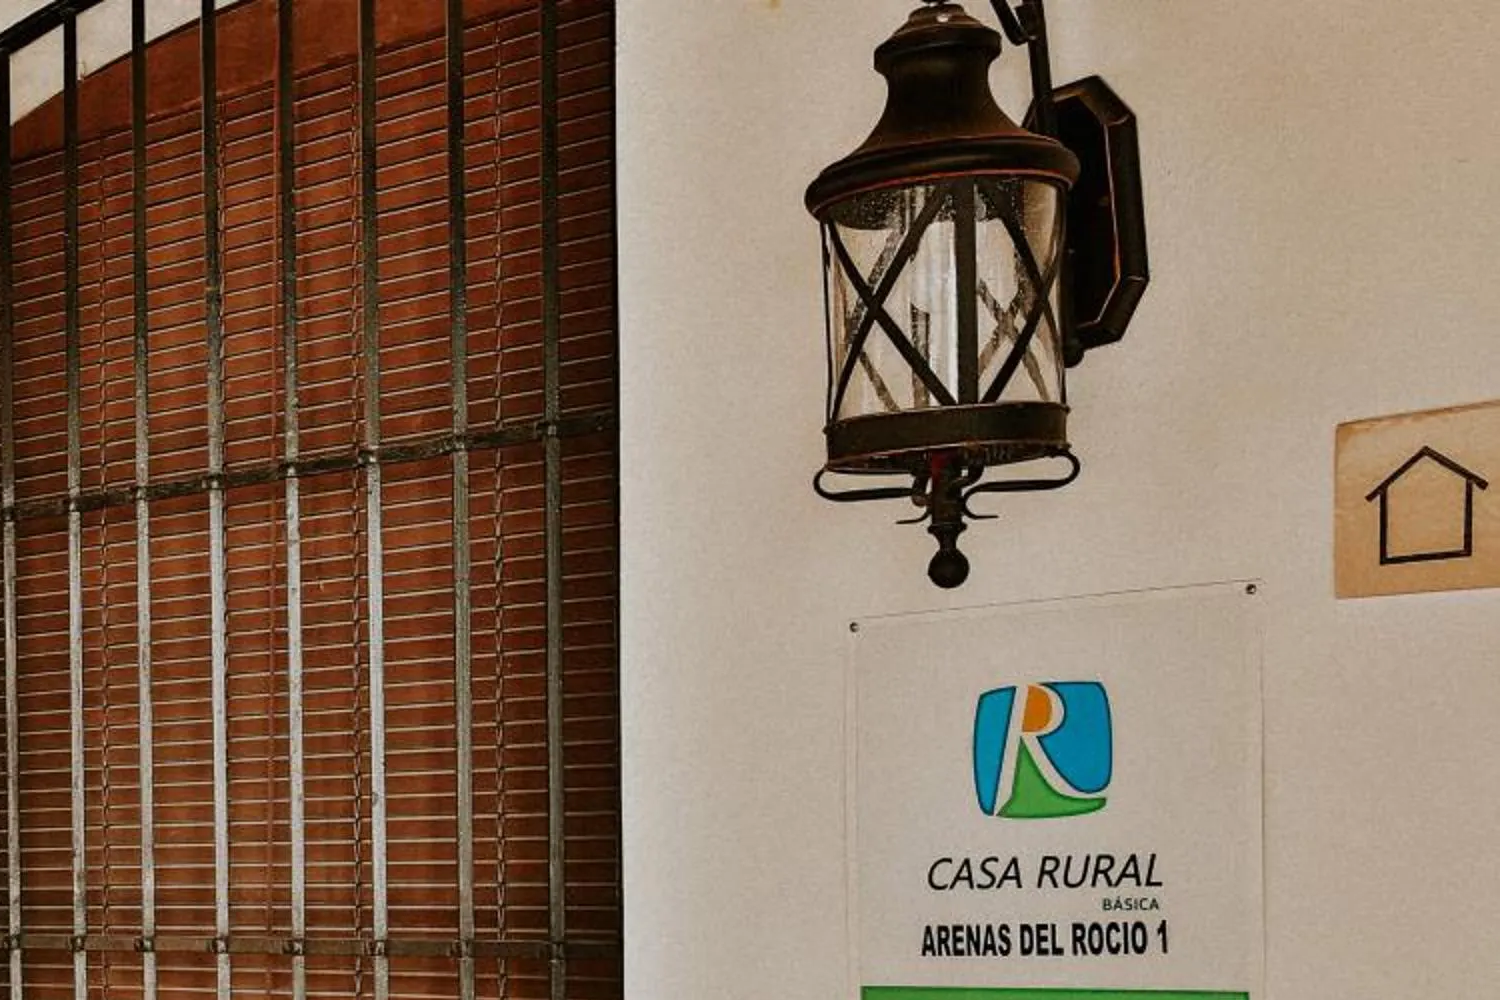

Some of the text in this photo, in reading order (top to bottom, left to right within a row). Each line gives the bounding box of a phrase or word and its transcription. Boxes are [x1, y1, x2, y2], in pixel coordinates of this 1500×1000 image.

[926, 852, 1164, 891] CASA RURAL
[1101, 895, 1161, 912] BÁSICA
[920, 918, 1169, 957] ARENAS DEL ROCIO 1
